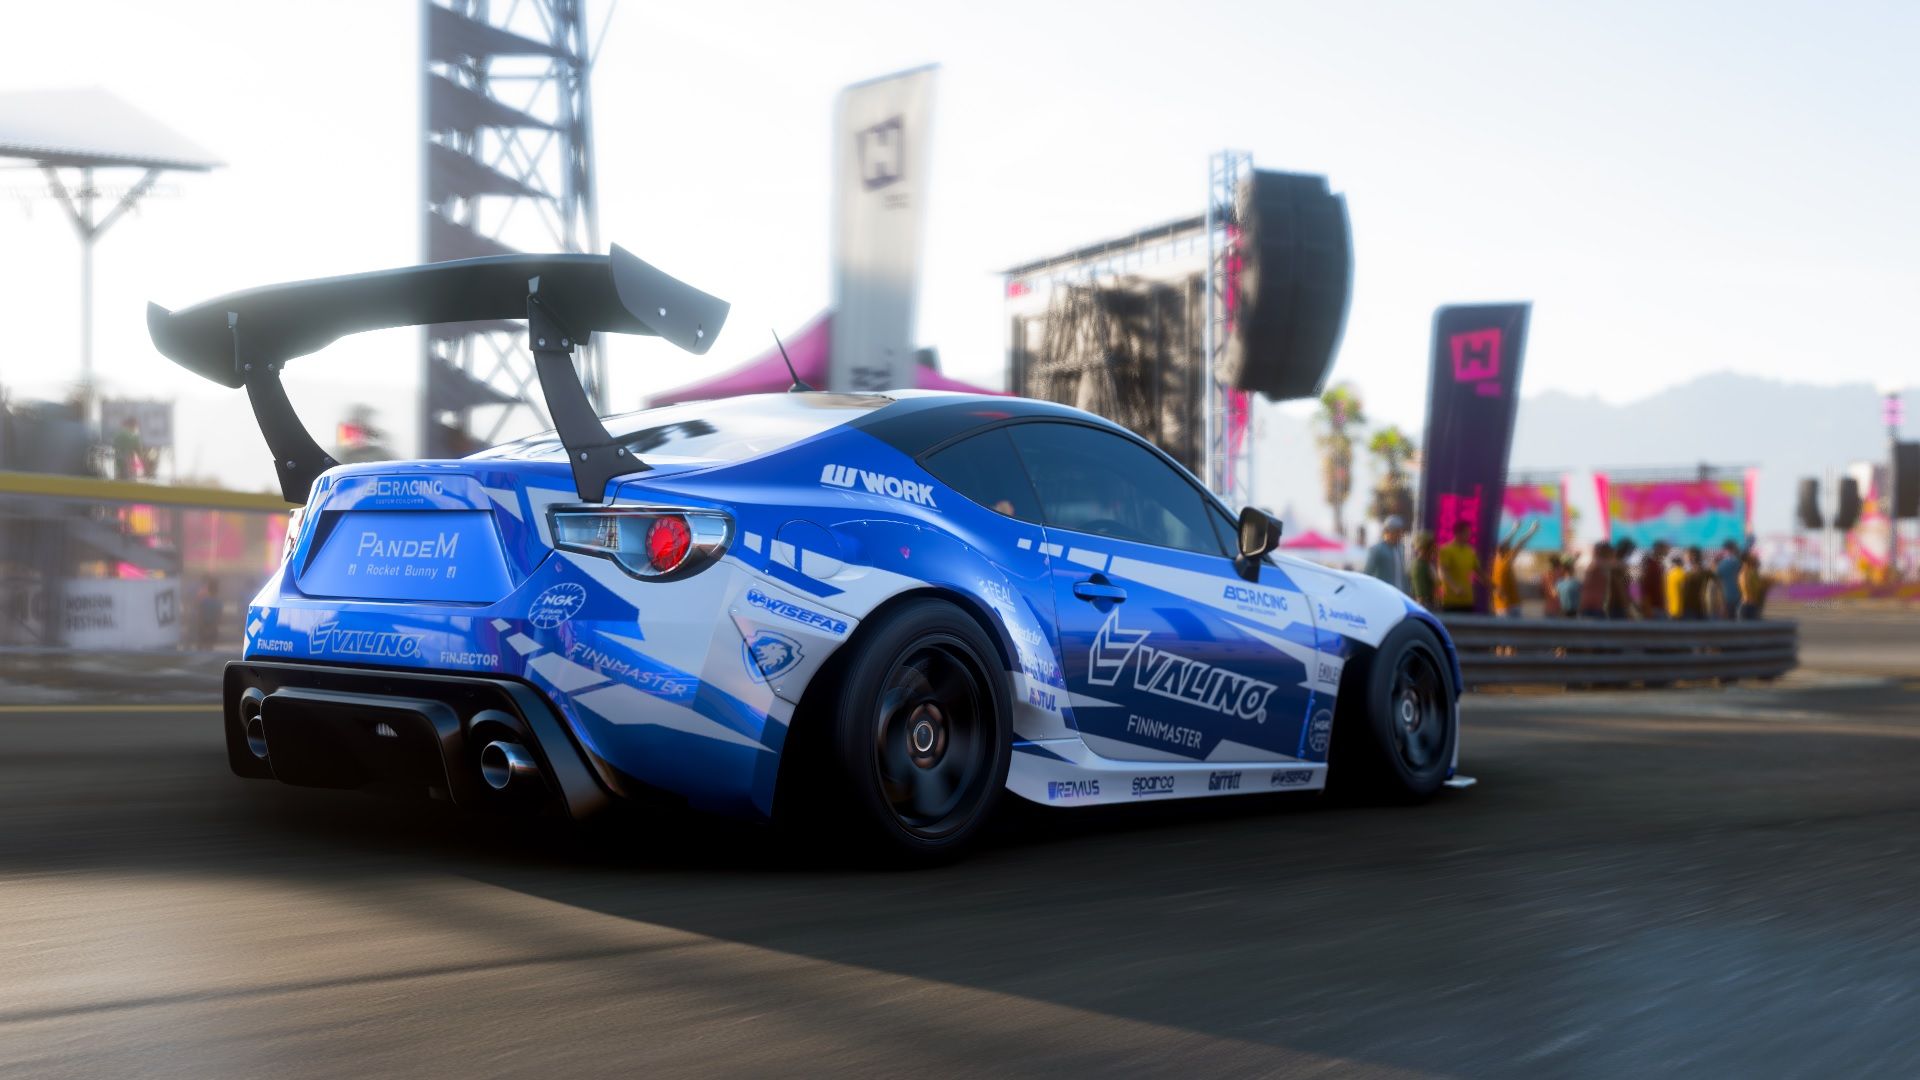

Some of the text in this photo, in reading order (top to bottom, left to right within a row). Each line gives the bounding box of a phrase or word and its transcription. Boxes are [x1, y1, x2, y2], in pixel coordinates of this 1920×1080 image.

[859, 469, 938, 508] WORK
[366, 564, 439, 579] Rocket Bunny
[542, 594, 578, 606] NGK
[765, 597, 848, 635] WISEFAB
[332, 629, 425, 658] VALINO
[571, 642, 688, 697] FINNMASTER
[1134, 644, 1279, 720] VALINO
[1127, 714, 1203, 749] FINNMASTER
[1056, 779, 1100, 798] REMUS
[1132, 775, 1175, 797] sparco
[1208, 771, 1242, 791] Garrett
